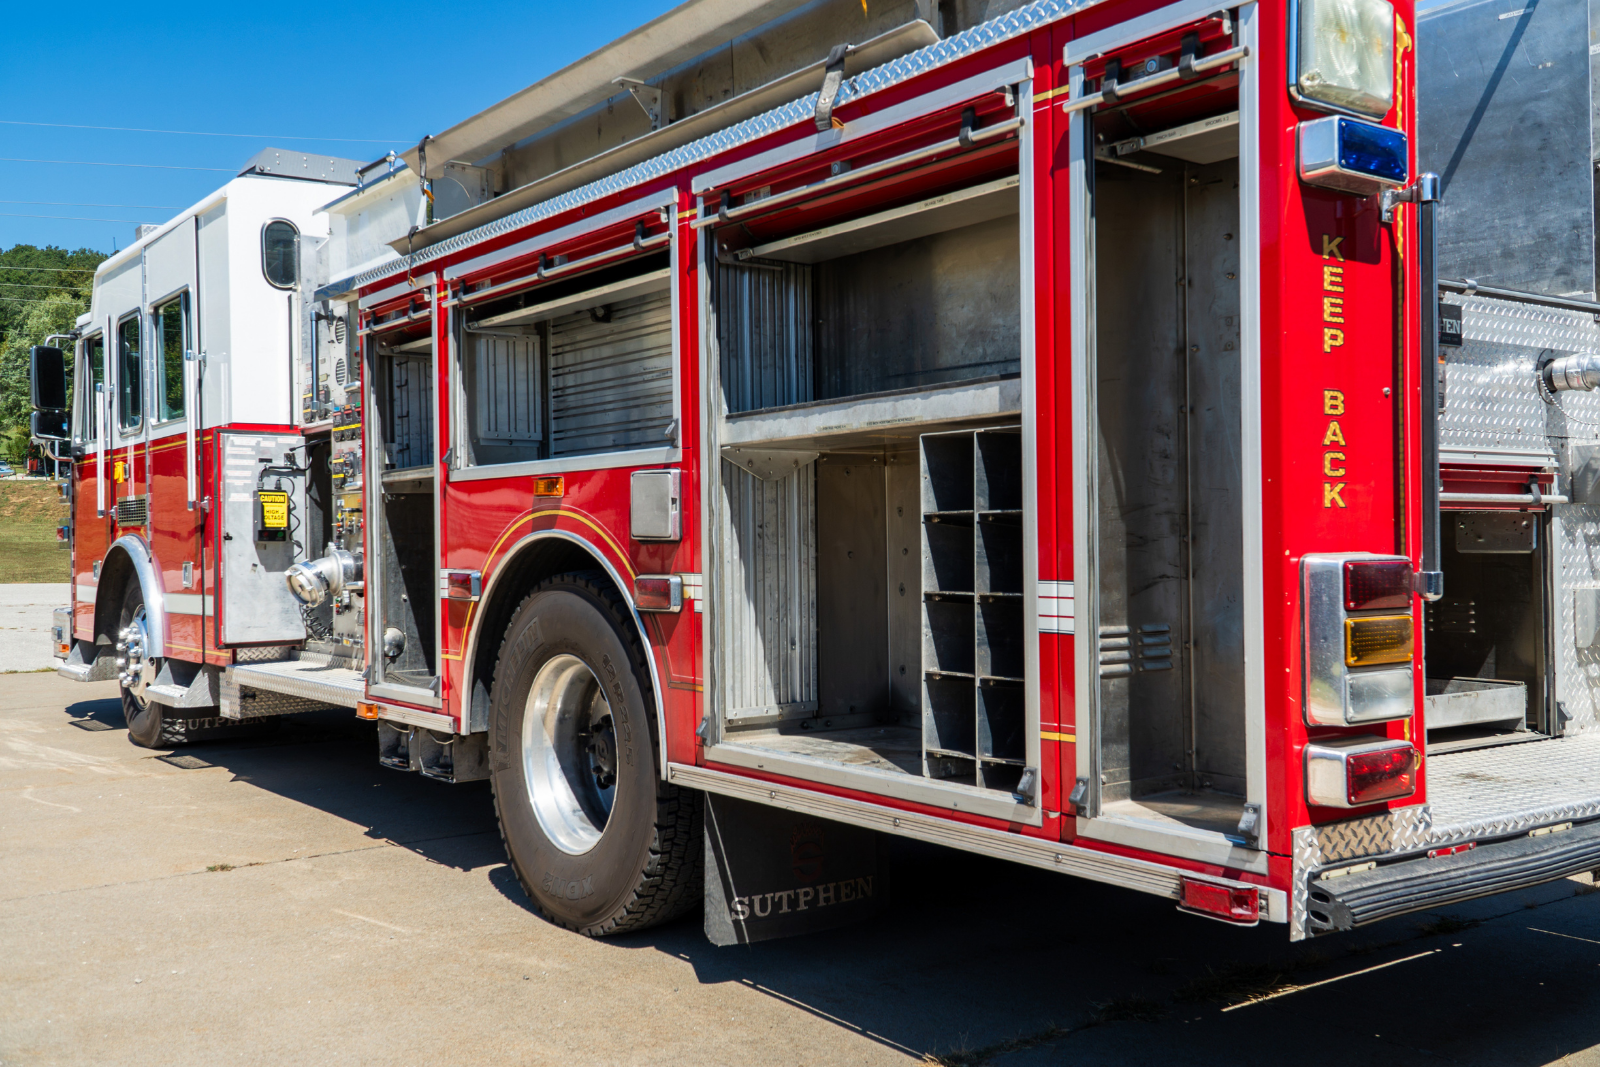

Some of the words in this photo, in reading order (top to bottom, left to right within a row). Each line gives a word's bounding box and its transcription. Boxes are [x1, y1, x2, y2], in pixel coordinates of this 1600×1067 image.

[1322, 233, 1346, 353] KEEP
[1322, 389, 1346, 508] BACK
[497, 619, 539, 746] MICHELIN
[542, 872, 594, 900] XDN2
[730, 876, 874, 921] SUTPHEN
